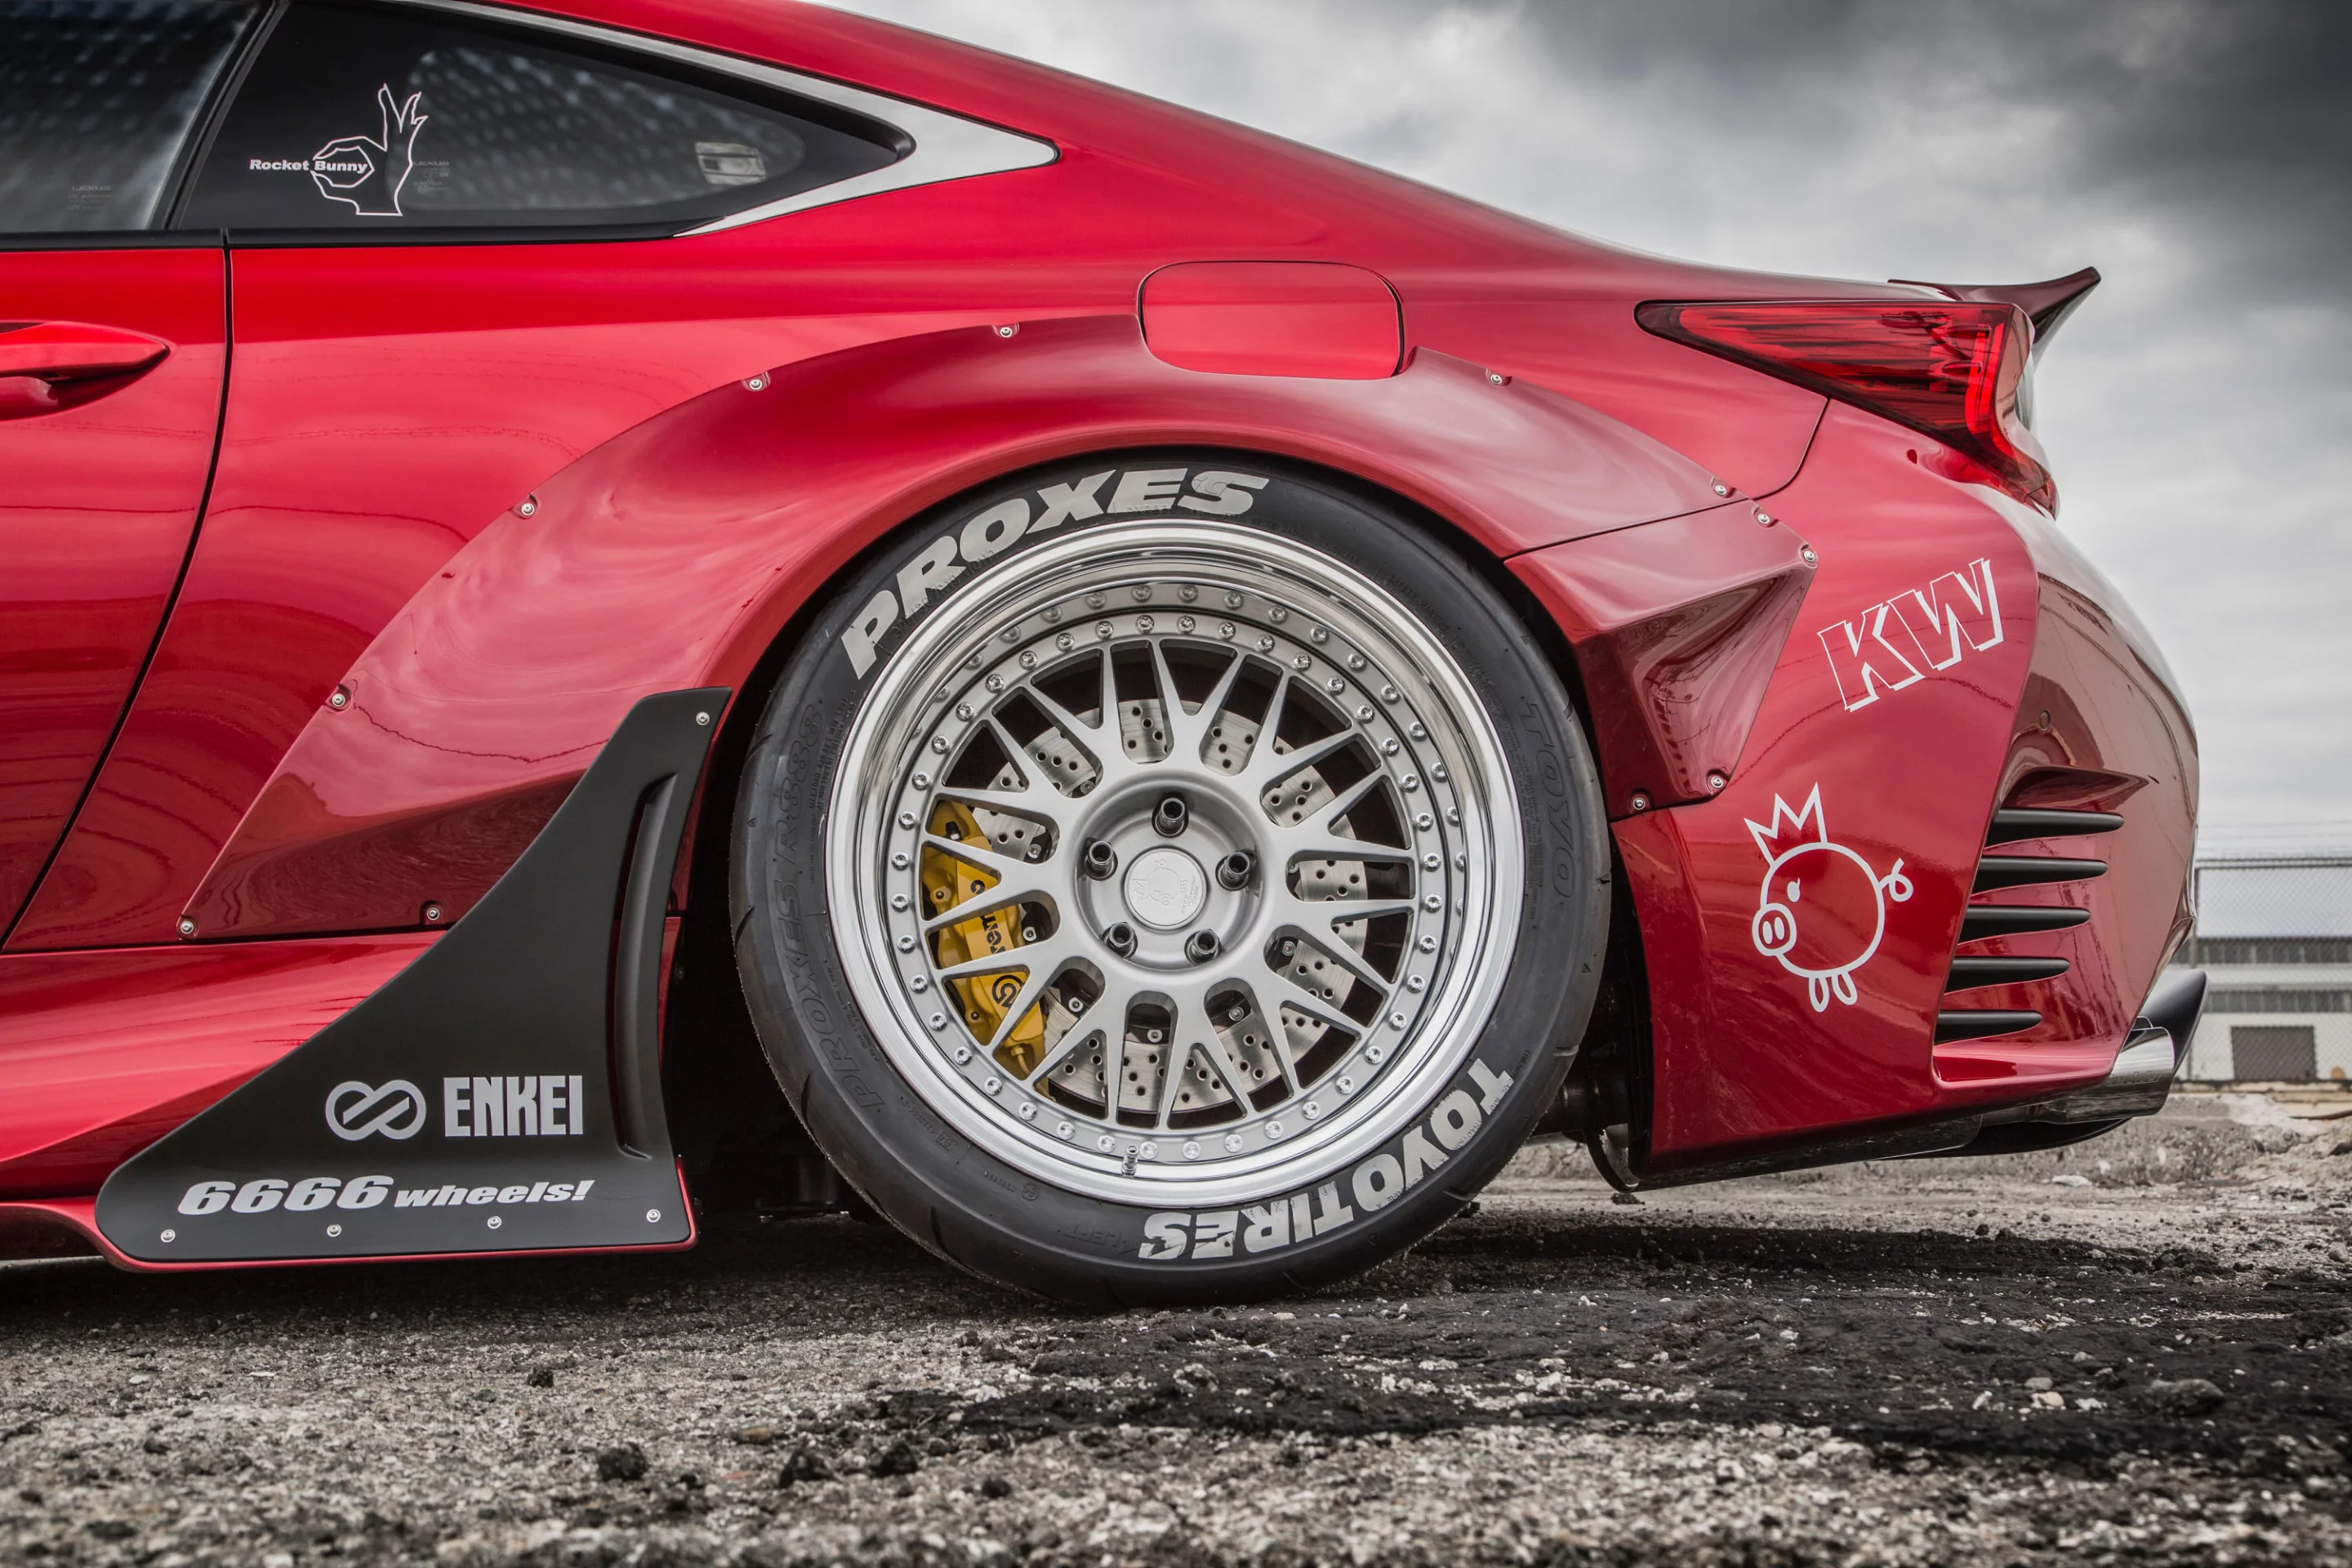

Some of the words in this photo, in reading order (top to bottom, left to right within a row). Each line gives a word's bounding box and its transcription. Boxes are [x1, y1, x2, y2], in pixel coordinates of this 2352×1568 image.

[249, 159, 310, 171] Rocket
[314, 160, 368, 174] Bunny
[840, 468, 1269, 679] PROXES
[1816, 558, 2004, 713] KW
[775, 703, 823, 866] R888
[1521, 702, 1575, 898] TOYO
[774, 878, 886, 1107] PROXES
[443, 1075, 584, 1137] ENKEI
[1352, 1058, 1515, 1212] TOYO
[177, 1175, 394, 1215] 6666
[394, 1180, 595, 1208] wheels!
[1063, 1223, 1122, 1249] LEFT
[1138, 1181, 1354, 1260] TIRES
